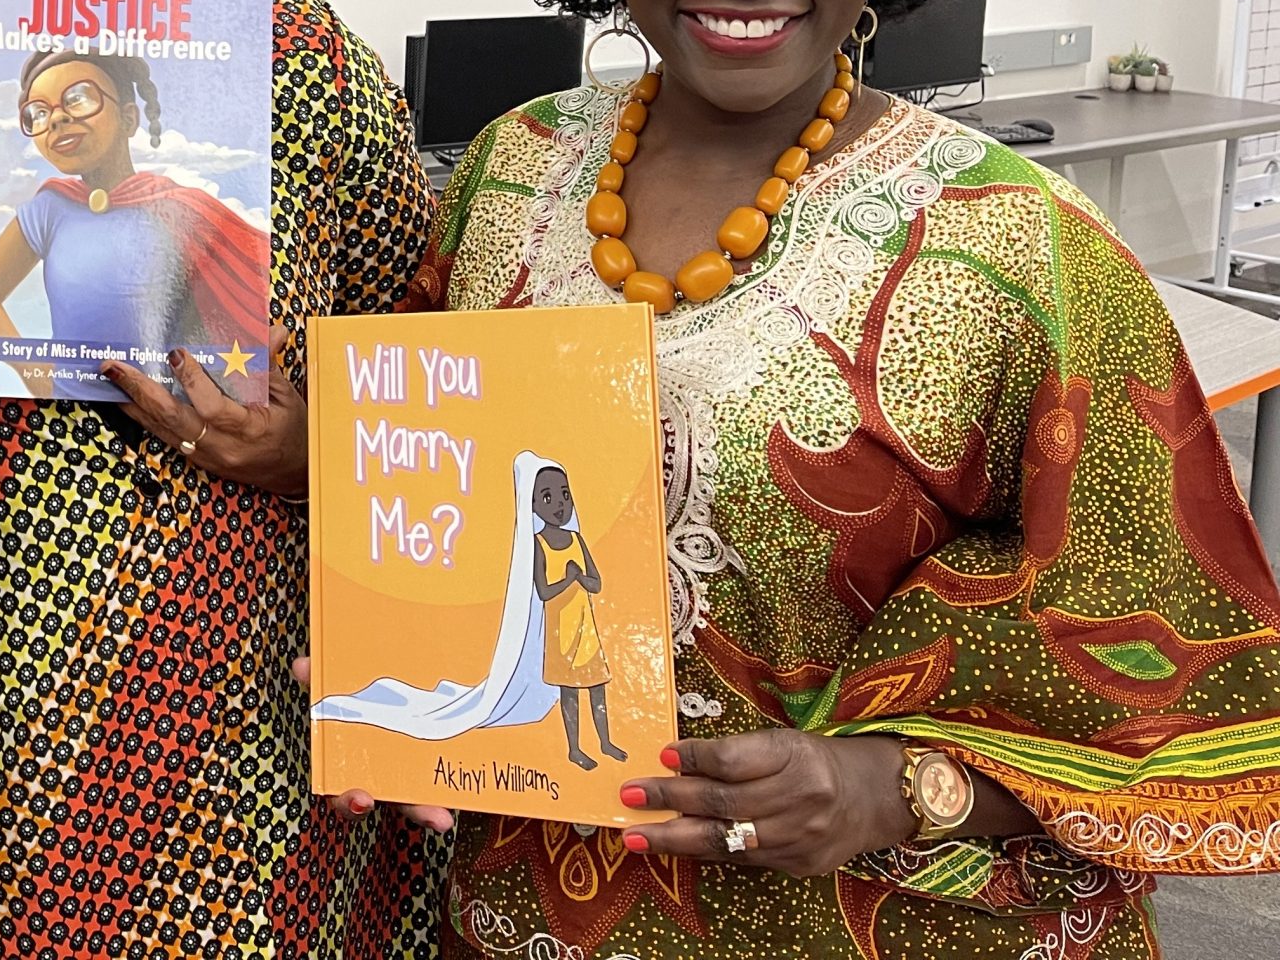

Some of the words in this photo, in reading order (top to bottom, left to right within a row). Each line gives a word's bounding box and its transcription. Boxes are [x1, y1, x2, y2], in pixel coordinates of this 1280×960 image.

[73, 34, 90, 56] a
[99, 28, 232, 61] Difference
[2, 341, 33, 360] Story
[36, 342, 48, 357] of
[51, 343, 77, 358] Miss
[80, 344, 127, 360] Freedom
[130, 347, 170, 365] Fighter,
[23, 369, 32, 379] by
[34, 368, 45, 378] Dr.
[75, 370, 97, 381] Tyner
[346, 343, 405, 402] Will
[418, 348, 479, 407] You
[355, 419, 474, 494] Marry
[370, 496, 463, 567] Me?
[434, 756, 486, 794] Akinyi
[492, 761, 559, 800] Williams
